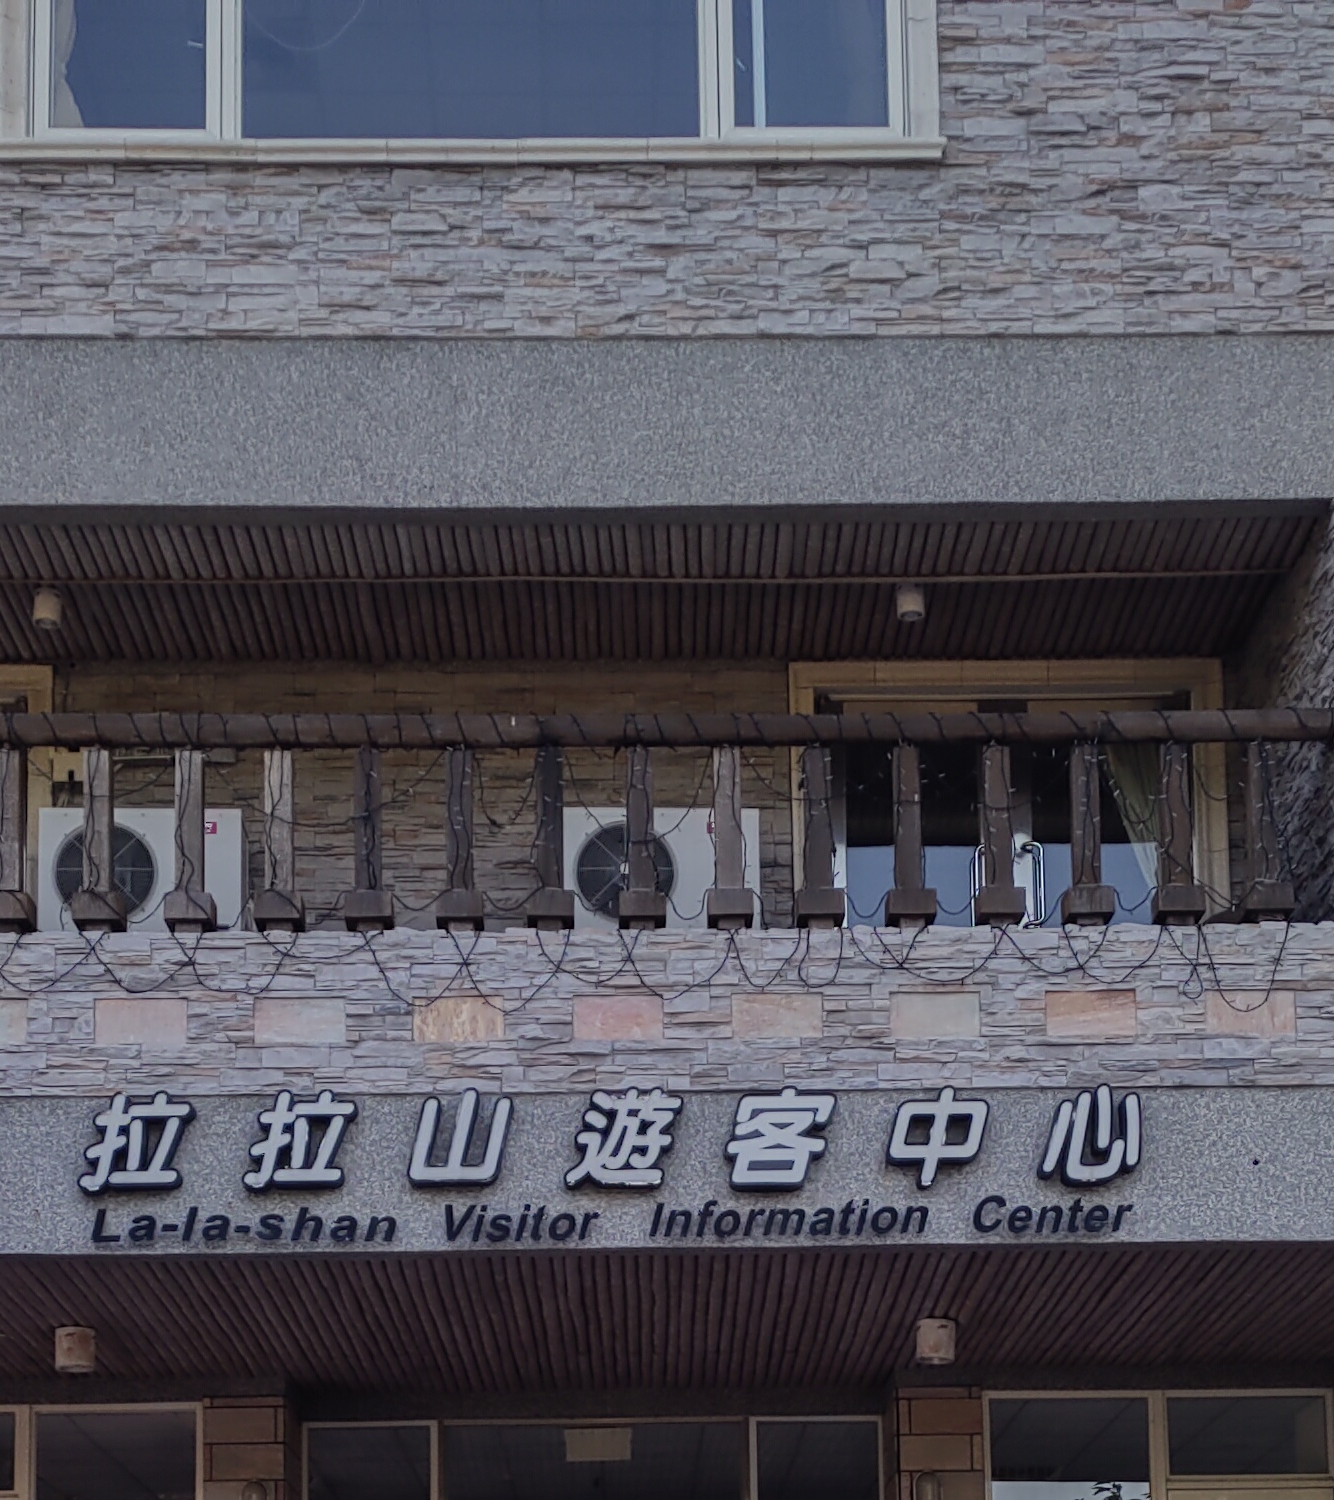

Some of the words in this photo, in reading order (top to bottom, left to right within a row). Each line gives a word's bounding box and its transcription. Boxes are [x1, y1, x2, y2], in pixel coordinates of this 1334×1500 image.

[77, 1083, 1143, 1195] 拉拉山遊客中心
[90, 1205, 398, 1244] La-la-shan
[444, 1203, 600, 1243] Visitor
[649, 1198, 930, 1239] Information
[972, 1195, 1135, 1234] Center
